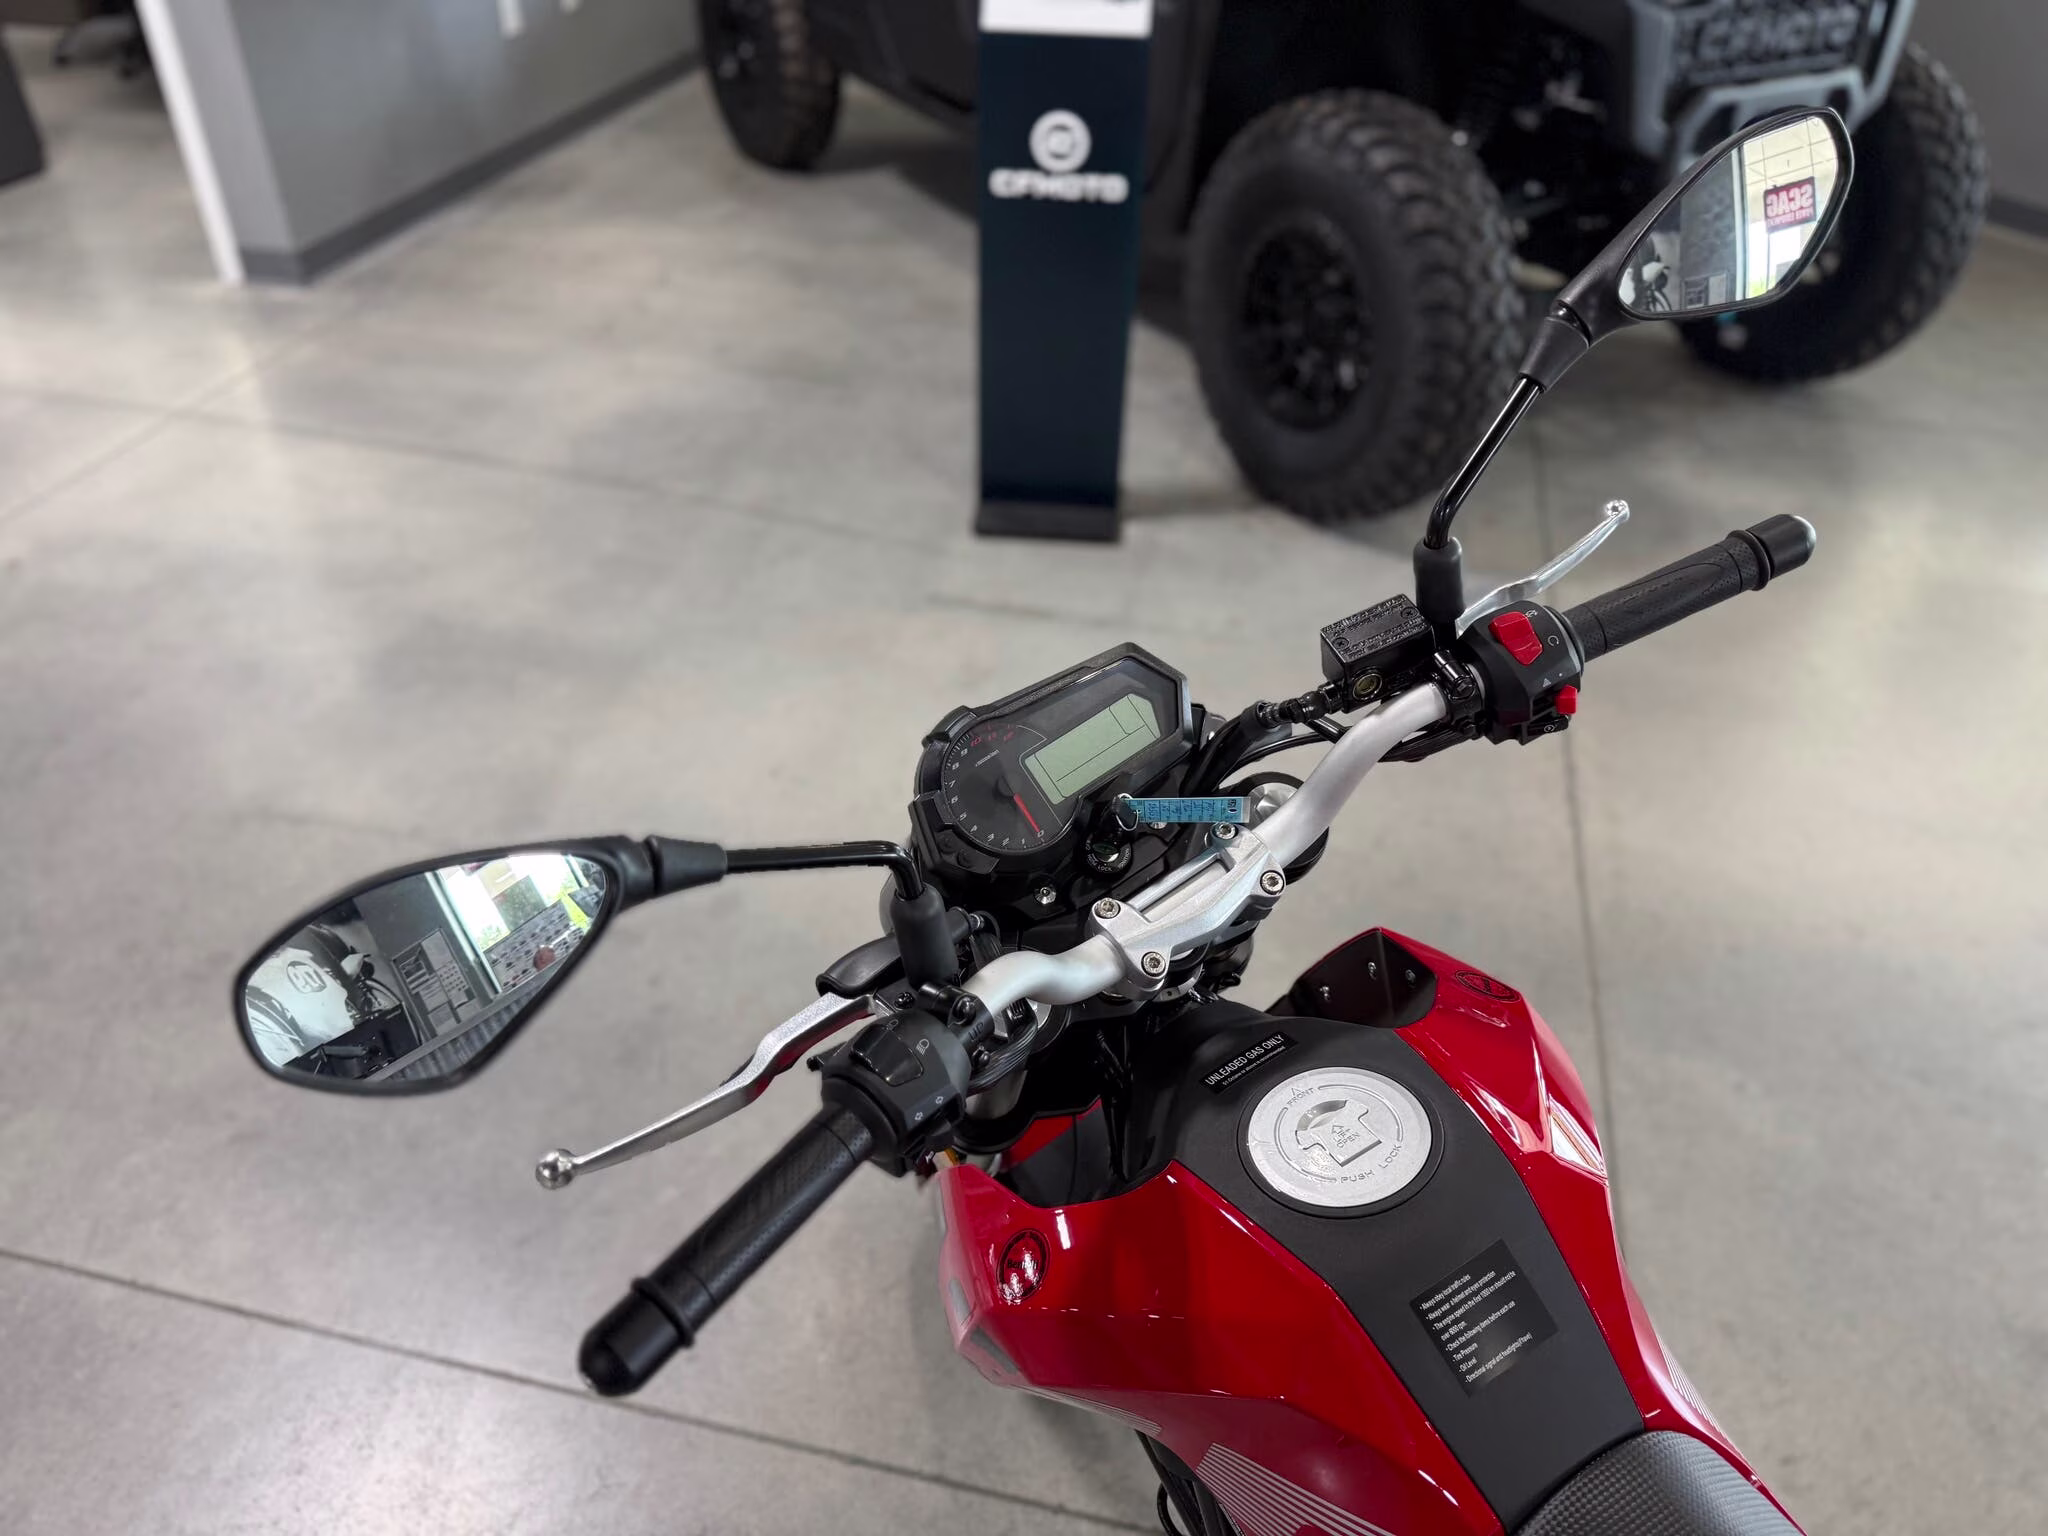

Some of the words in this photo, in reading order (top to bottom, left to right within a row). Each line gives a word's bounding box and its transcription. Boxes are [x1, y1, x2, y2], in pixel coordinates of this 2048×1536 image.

[1205, 1056, 1248, 1085] UNLEADED
[1245, 1046, 1265, 1059] GAS
[1262, 1034, 1284, 1049] ONLY
[1287, 1087, 1314, 1107] FRONT
[1379, 1144, 1402, 1169] LOCK
[1341, 1169, 1375, 1184] PUSH
[1007, 1258, 1038, 1269] Benlli
